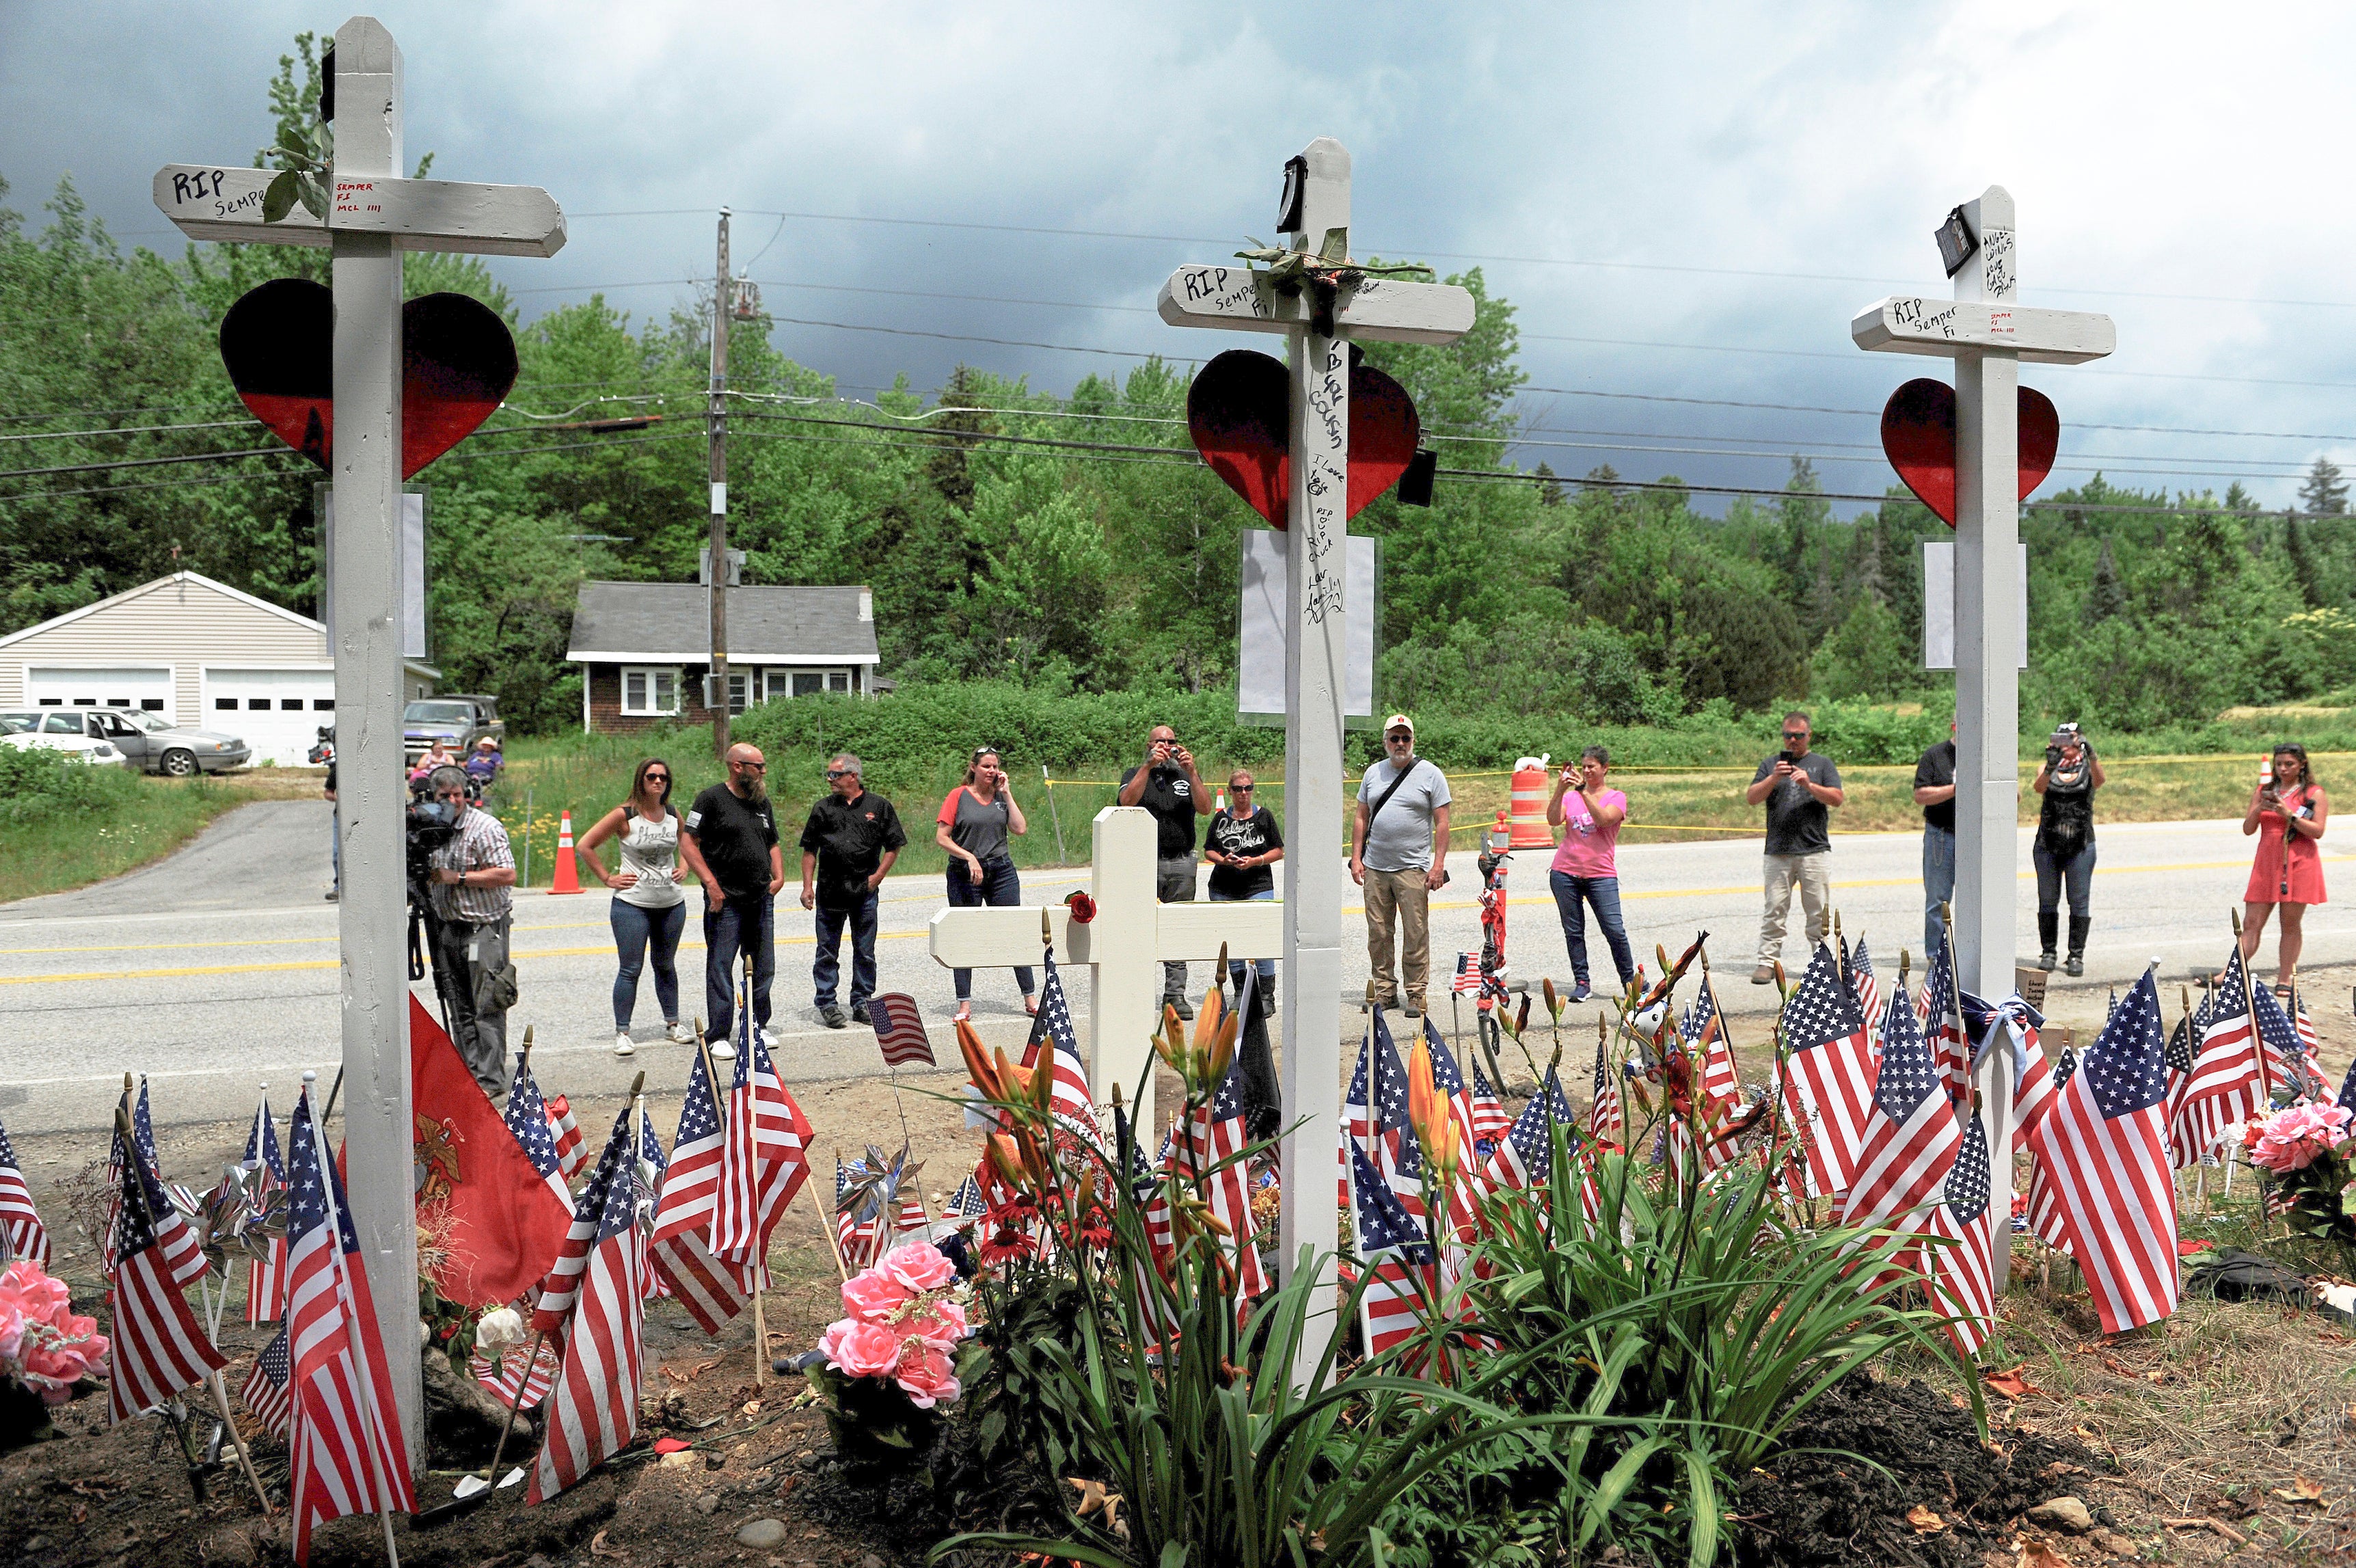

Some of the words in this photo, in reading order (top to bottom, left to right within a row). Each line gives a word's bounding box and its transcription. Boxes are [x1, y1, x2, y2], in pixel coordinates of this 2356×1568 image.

[172, 170, 226, 204] RIP
[336, 183, 373, 191] SEMPER
[337, 193, 351, 202] FI
[1983, 226, 2008, 251] ANGEL
[1184, 268, 1228, 301] RIP
[1894, 298, 1922, 325] RIP
[1943, 325, 1955, 338] Fi
[636, 826, 676, 845] Harley
